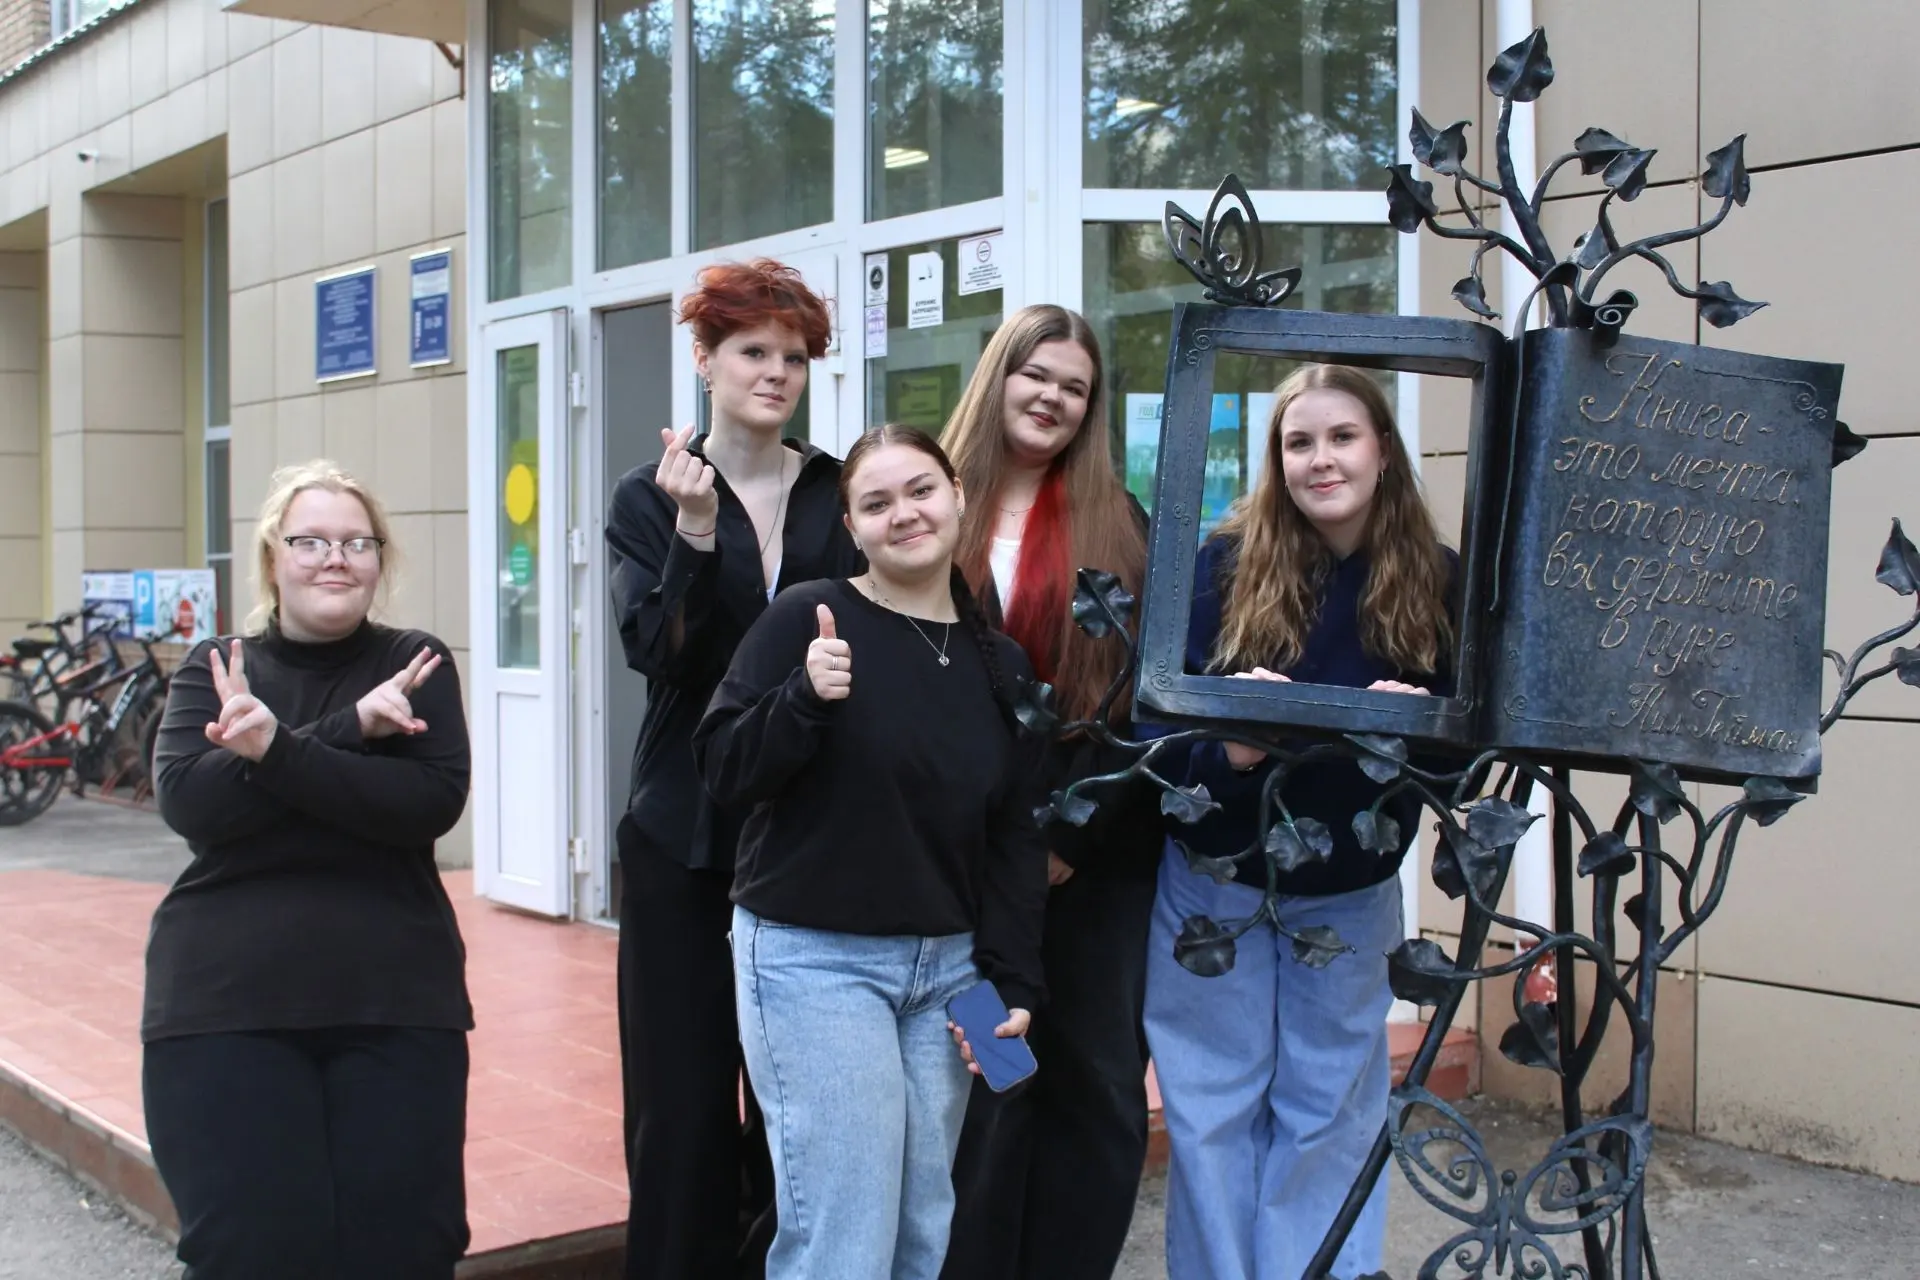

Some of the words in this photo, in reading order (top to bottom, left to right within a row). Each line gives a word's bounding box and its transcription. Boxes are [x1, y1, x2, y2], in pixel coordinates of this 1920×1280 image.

[1578, 351, 1751, 446] Книга
[1553, 435, 1642, 482] это
[1560, 493, 1766, 567] которую
[1542, 530, 1604, 592] вы
[1594, 556, 1799, 622] держите
[1599, 596, 1638, 650] в
[1606, 683, 1684, 736] Нил
